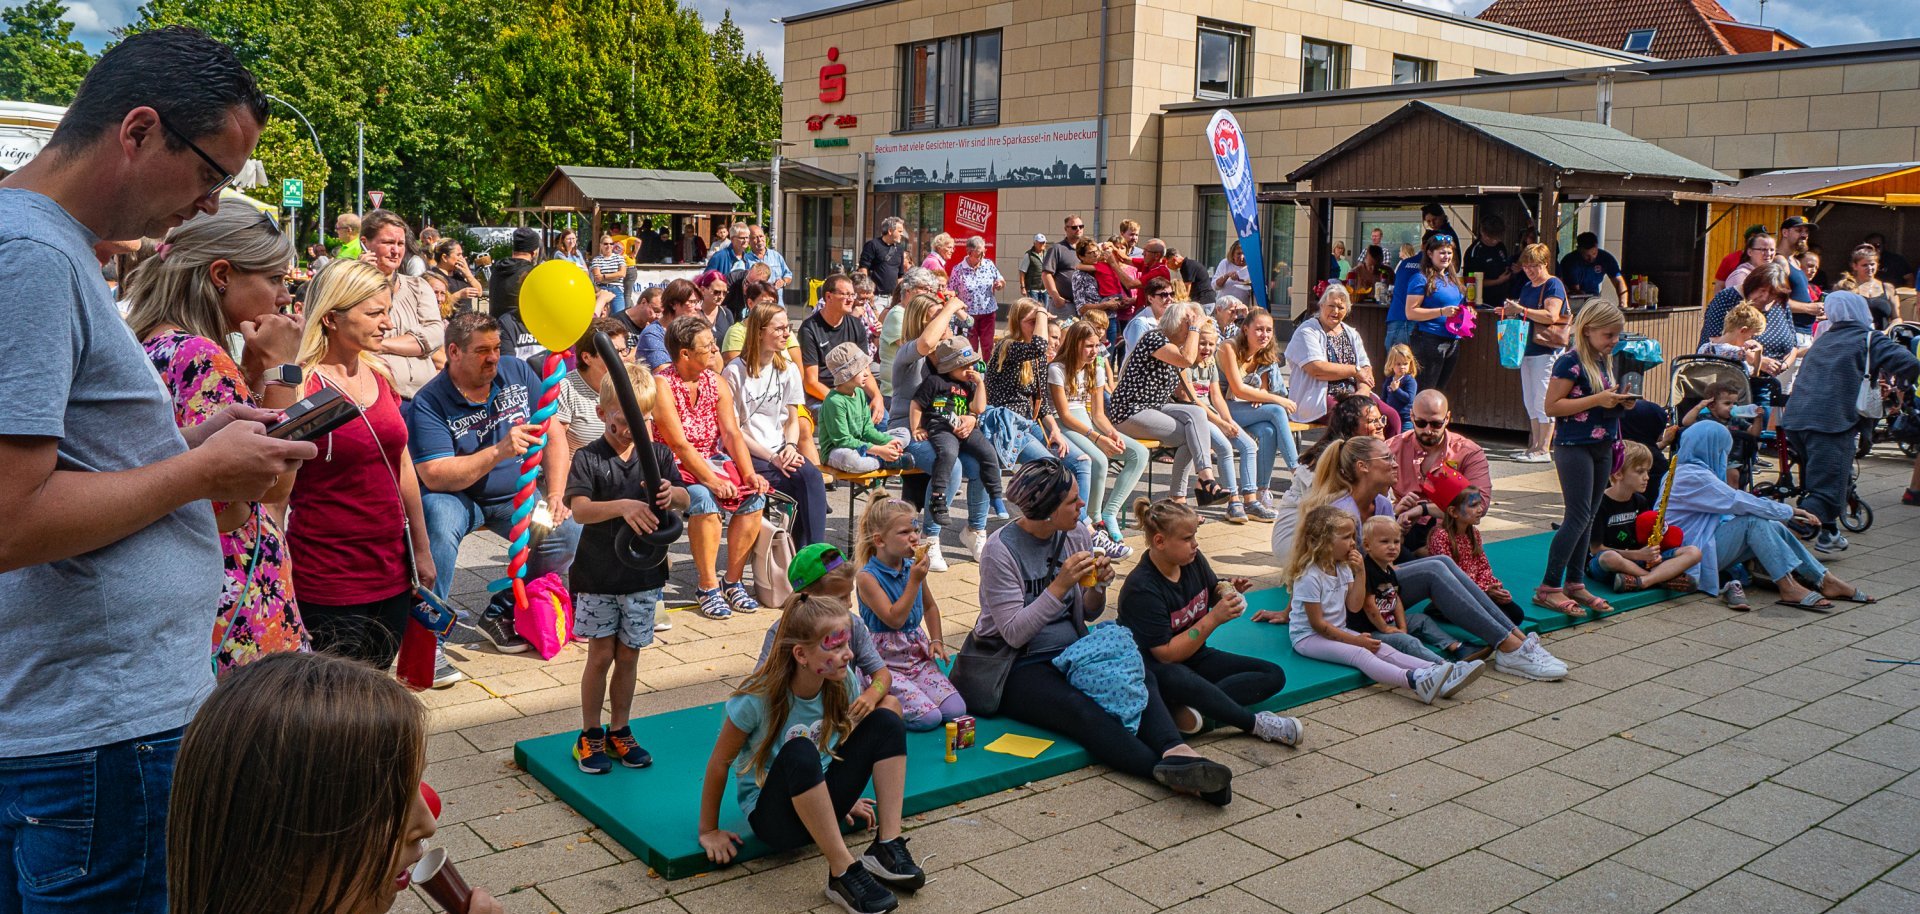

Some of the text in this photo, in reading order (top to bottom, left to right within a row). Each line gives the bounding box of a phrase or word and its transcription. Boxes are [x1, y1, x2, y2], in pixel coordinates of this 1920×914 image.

[875, 144, 898, 154] Beckum
[899, 143, 909, 152] hat
[910, 141, 926, 151] viele
[972, 137, 986, 148] sind
[987, 136, 1001, 146] Ihre
[1053, 129, 1099, 141] Neubeckum
[958, 207, 981, 223] CHECK
[959, 198, 987, 215] FINANZ
